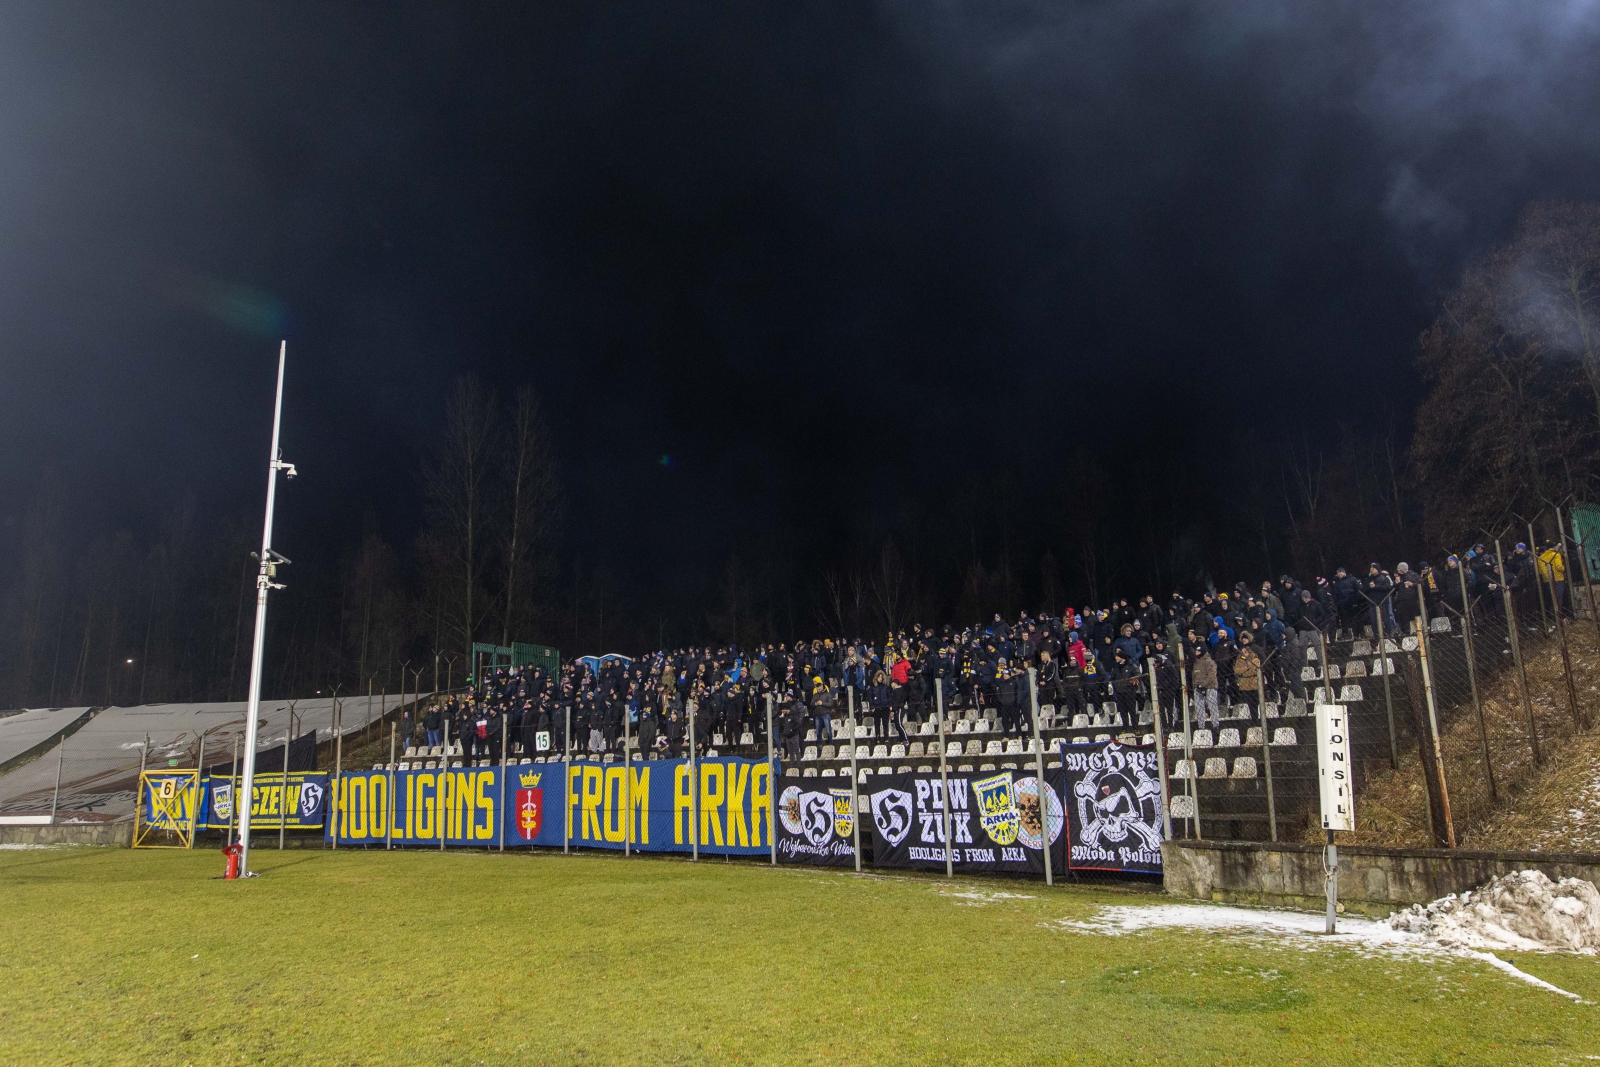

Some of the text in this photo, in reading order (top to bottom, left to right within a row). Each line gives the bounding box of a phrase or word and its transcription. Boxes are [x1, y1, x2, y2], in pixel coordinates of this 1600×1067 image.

[537, 734, 548, 748] 15
[1330, 718, 1347, 814] TONSIL
[164, 782, 172, 796] 6
[914, 778, 968, 809] PDW
[330, 762, 772, 847] HOOLIGANS FROM ARKA
[986, 812, 1016, 826] ARKA
[908, 846, 1028, 862] HOOLIGAS FROM ARKA
